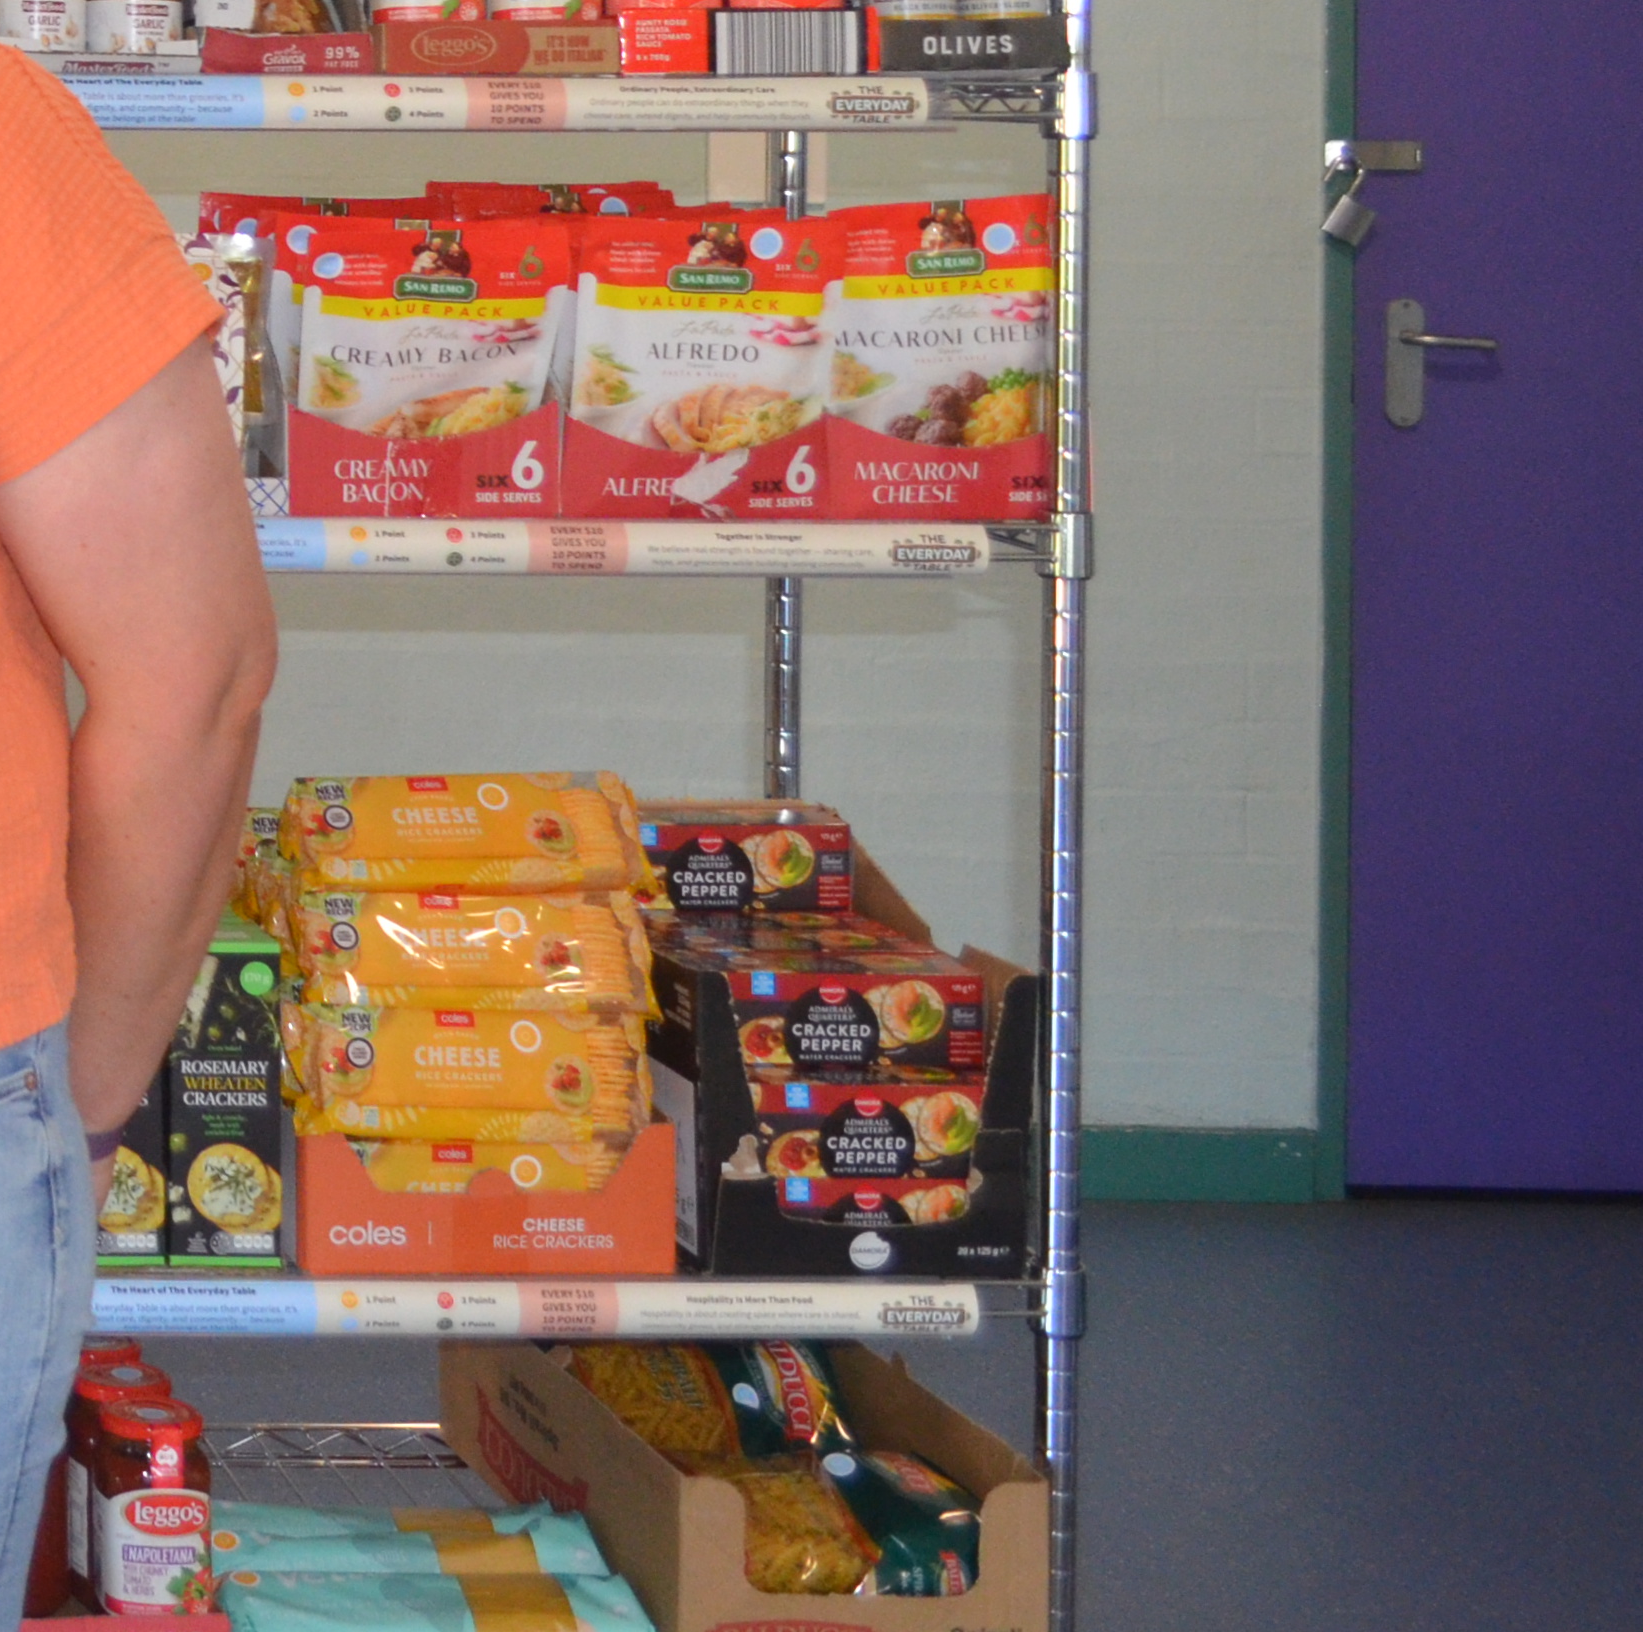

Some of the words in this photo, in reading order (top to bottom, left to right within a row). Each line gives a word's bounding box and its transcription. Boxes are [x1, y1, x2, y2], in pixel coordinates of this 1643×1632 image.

[325, 47, 360, 60] 99%
[922, 34, 1014, 56] OLIVES
[836, 99, 910, 111] EVERYDAY
[676, 273, 697, 288] SAN
[700, 273, 739, 288] REMO
[638, 294, 706, 311] VALUE
[720, 297, 780, 312] PACK
[329, 344, 430, 366] CREAMY
[438, 341, 519, 363] BACON
[646, 342, 761, 363] ALFREDO
[333, 459, 430, 480] CREAMY
[476, 475, 508, 488] SIX
[511, 441, 545, 490] 6
[855, 460, 979, 481] MACARONI
[342, 482, 424, 503] BACON
[475, 491, 499, 503] SIDE
[501, 492, 542, 503] SERVES
[872, 482, 960, 504] CHEESE
[673, 871, 747, 885] CRACKED
[681, 885, 739, 898] PEPPER
[791, 1023, 872, 1037] CRACKED
[800, 1038, 863, 1053] PEPPER
[414, 1045, 501, 1067] CHEESE
[180, 1060, 269, 1075] ROSEMARY
[183, 1076, 266, 1091] WHEATEN
[182, 1090, 268, 1107] CRACKERS
[521, 1217, 585, 1233] CHEESE
[329, 1222, 407, 1246] coles
[492, 1233, 530, 1249] RICE
[533, 1233, 614, 1249] CRACKERS
[135, 1501, 204, 1527] Leggo's
